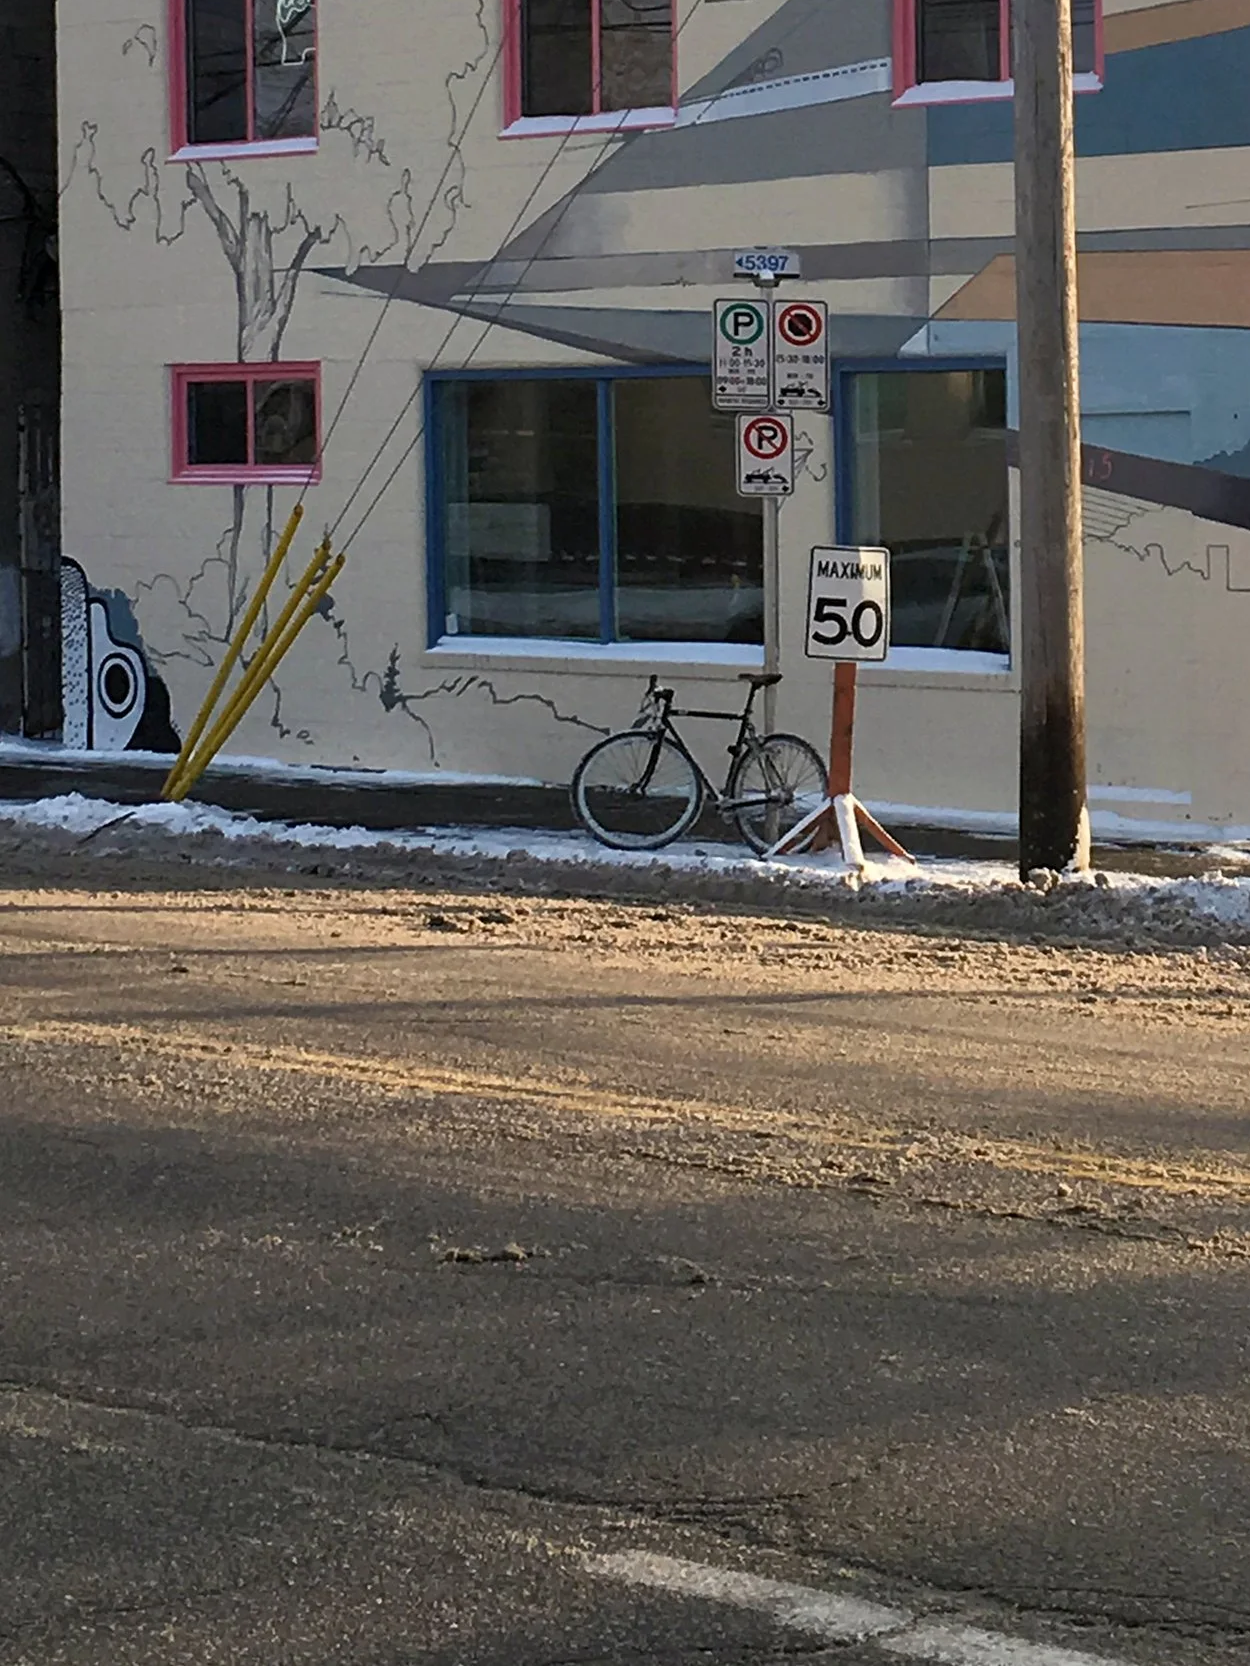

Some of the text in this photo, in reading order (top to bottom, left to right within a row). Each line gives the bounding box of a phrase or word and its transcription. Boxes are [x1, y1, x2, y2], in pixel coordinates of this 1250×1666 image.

[745, 255, 789, 271] 5397
[817, 560, 882, 581] MAXIMUM
[811, 597, 883, 648] 50
